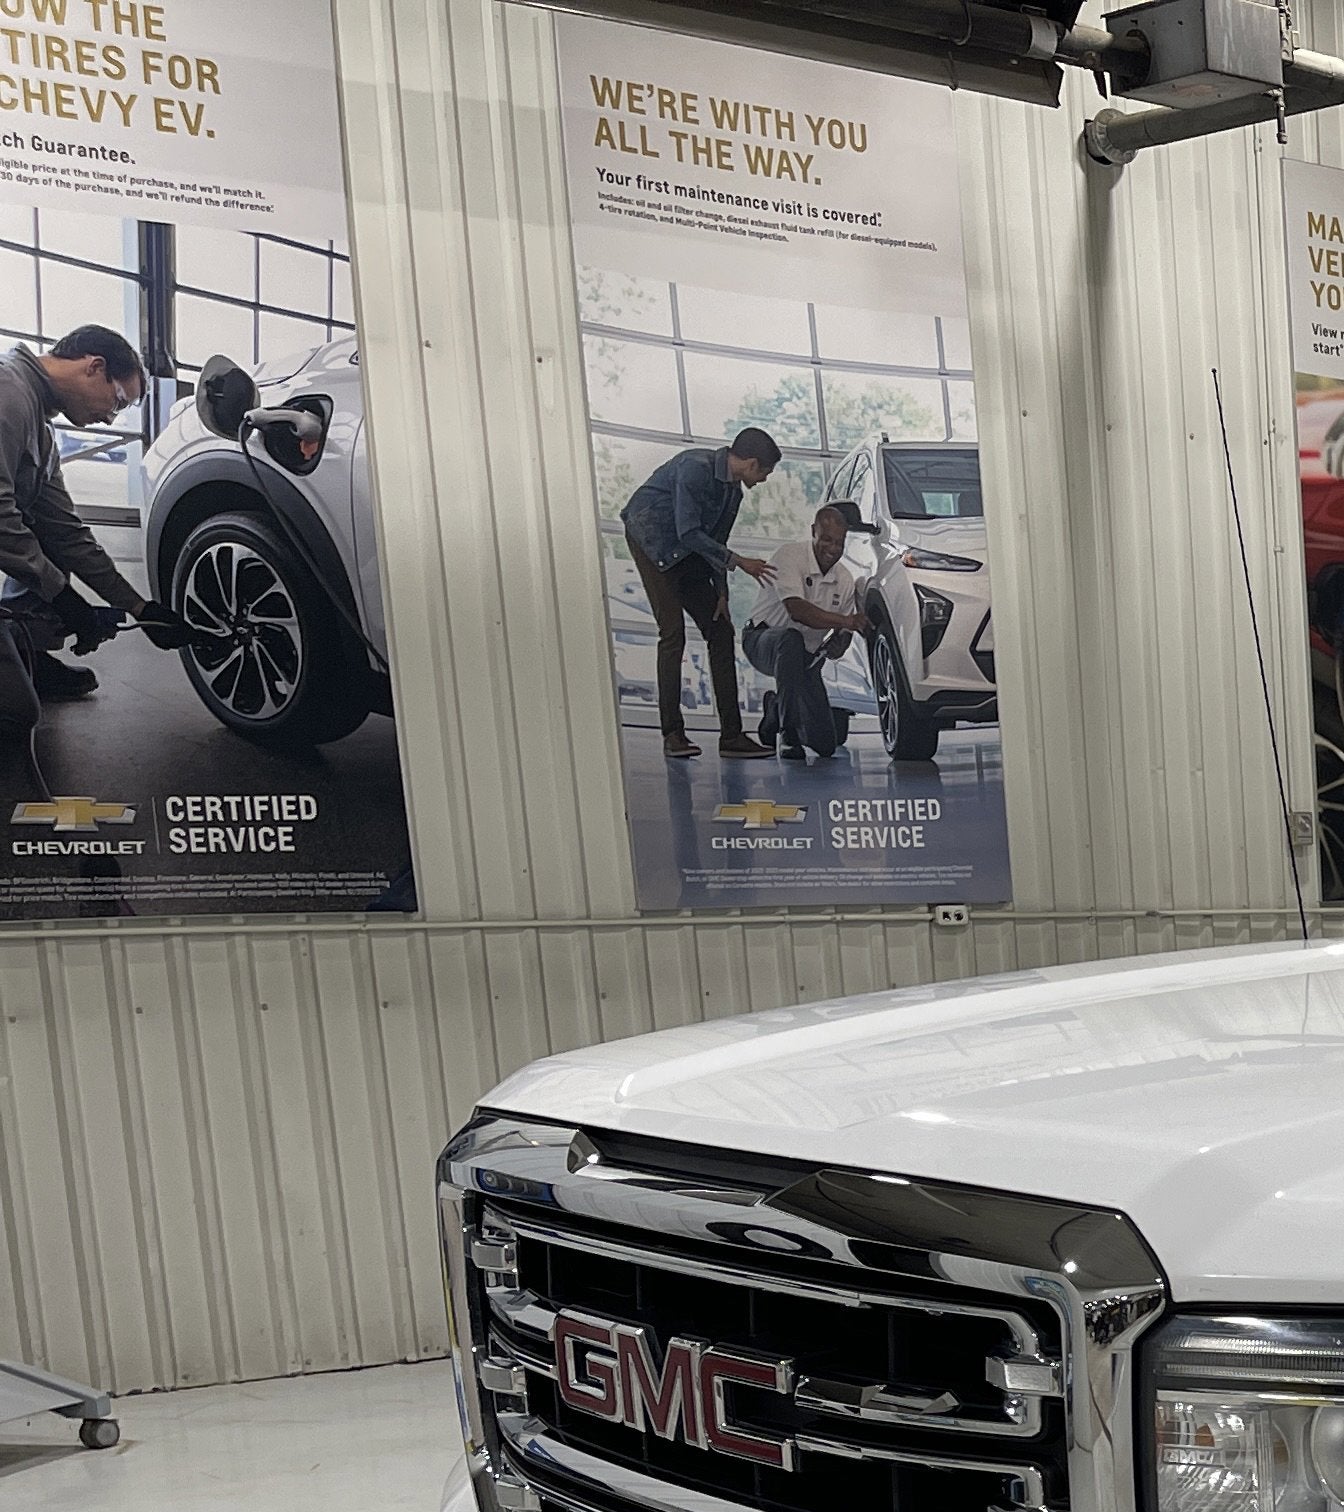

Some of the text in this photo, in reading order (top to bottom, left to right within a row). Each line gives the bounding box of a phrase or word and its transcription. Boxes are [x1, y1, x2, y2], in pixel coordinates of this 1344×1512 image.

[83, 0, 167, 42] THE
[0, 28, 221, 95] TIRES FOR
[0, 74, 215, 138] CHEVY EV.
[589, 74, 868, 152] WE'RE WITH YOU
[0, 132, 136, 165] ch Guarantee.
[594, 116, 822, 185] ALL THE WAY.
[16, 174, 40, 186] days
[42, 177, 53, 186] of
[55, 178, 72, 189] the
[74, 182, 124, 197] purchase,
[125, 189, 143, 198] and
[170, 194, 203, 205] refund
[204, 198, 221, 207] the
[31, 164, 58, 174] price
[60, 168, 71, 176] at
[73, 169, 90, 179] the
[92, 171, 115, 182] time
[117, 175, 128, 183] of
[130, 177, 178, 190] purchase,
[180, 182, 197, 192] and
[223, 187, 253, 199] match
[596, 167, 632, 187] Your
[635, 174, 671, 195] first
[674, 185, 769, 211] maintenance
[772, 198, 804, 216] visit
[806, 203, 818, 218] is
[599, 203, 789, 242] 4-tire rotation, and Multi-Point Vehicle Inspection.
[647, 201, 661, 211] and
[674, 205, 694, 216] filter
[695, 209, 726, 223] change,
[726, 215, 749, 226] diesel
[751, 218, 779, 231] exhaust
[781, 222, 798, 233] fluid
[799, 226, 816, 236] tank
[817, 229, 835, 238] refill
[836, 231, 849, 240] (for
[850, 232, 906, 248] diesel-equipped
[1311, 323, 1338, 339] View
[165, 795, 319, 823] CERTIFIED
[828, 799, 942, 822] CERTIFIED
[11, 840, 146, 855] CHEVROLET
[168, 826, 296, 854] SERVICE
[711, 837, 814, 849] CHEVROLET
[831, 825, 925, 849] SERVICE
[554, 1307, 799, 1473] GMC
